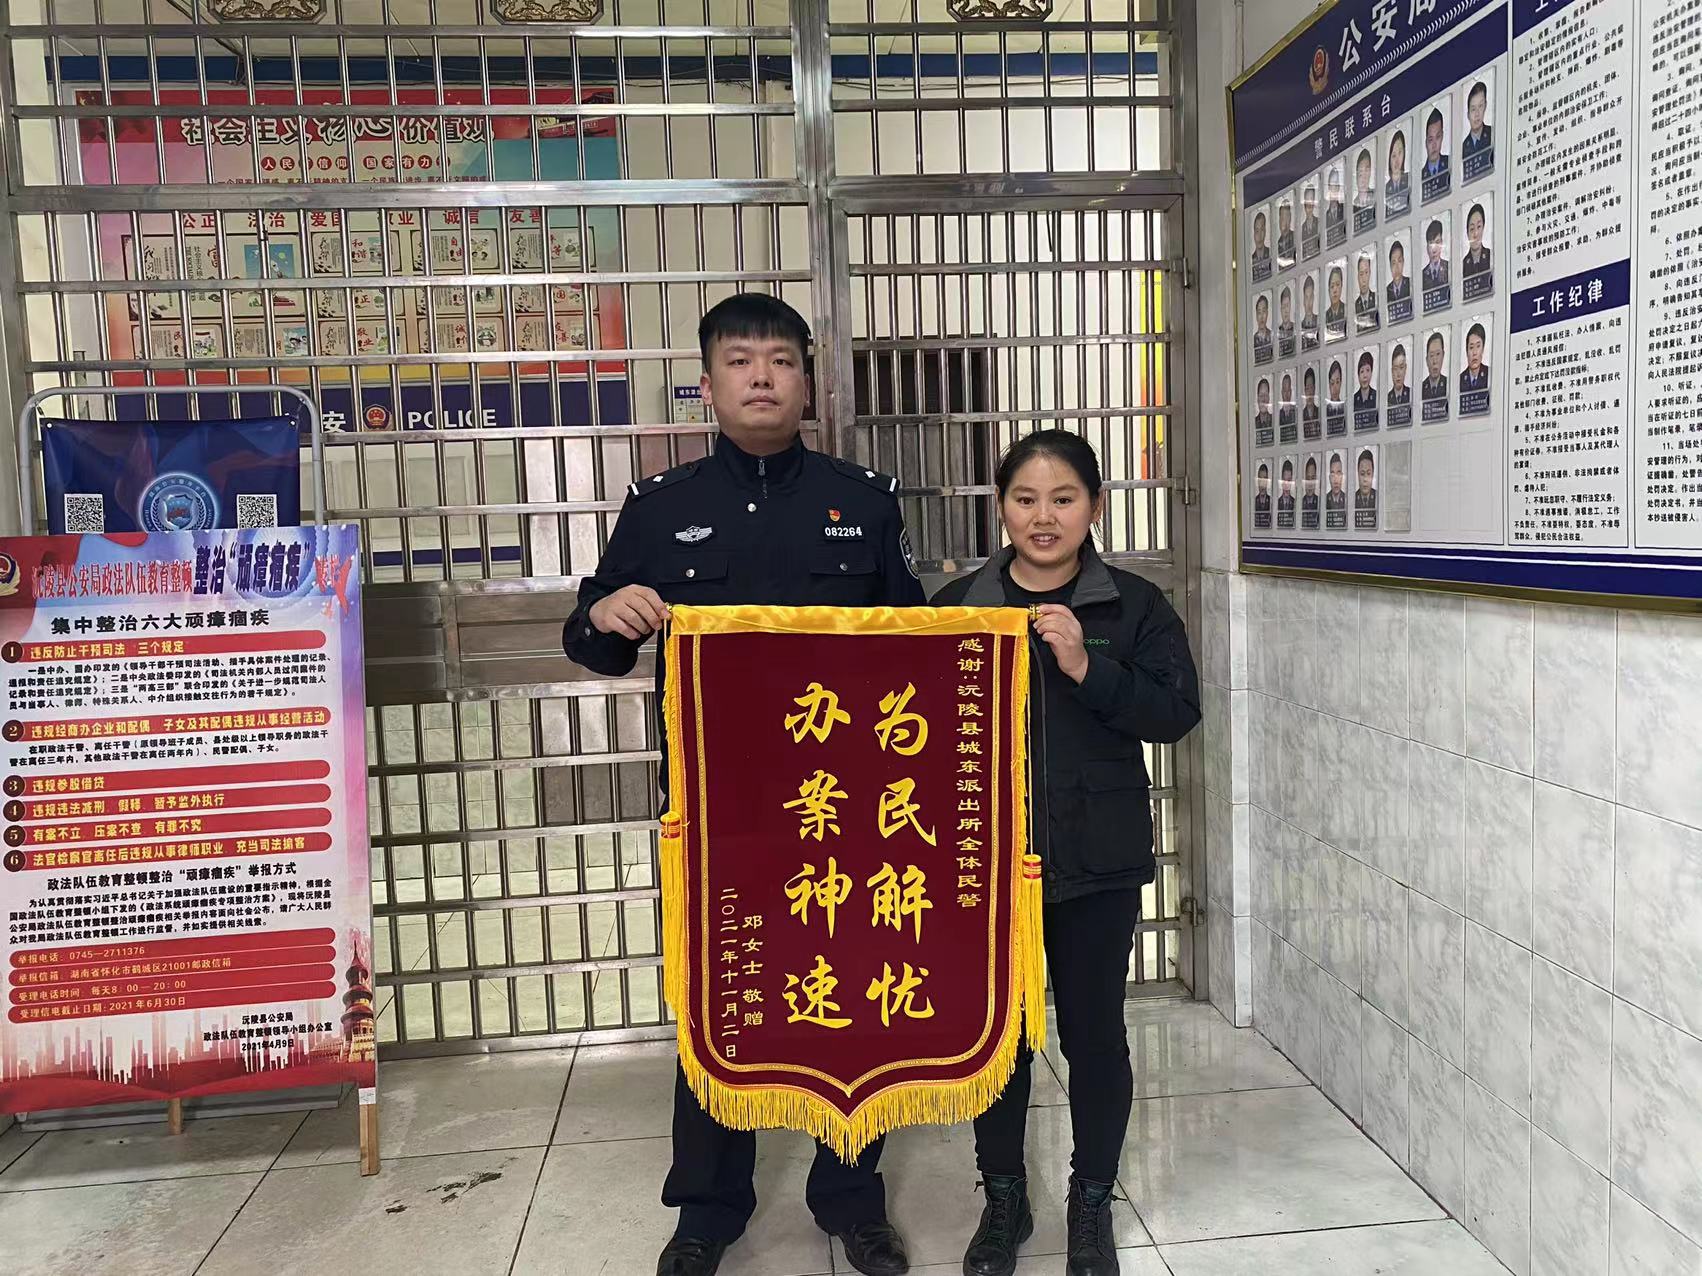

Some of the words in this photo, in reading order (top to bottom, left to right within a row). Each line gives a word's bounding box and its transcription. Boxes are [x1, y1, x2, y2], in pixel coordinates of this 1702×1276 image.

[1314, 94, 1391, 160] 警民联系台
[263, 157, 350, 171] 人民信仰
[366, 156, 450, 169] 国家有力
[1532, 277, 1603, 319] 工作纪律
[408, 408, 497, 431] POLICE
[824, 526, 863, 538] 082264
[51, 608, 270, 636] 集中整治六大顽瘴痼疾
[30, 642, 125, 660] 违反防止干预司法
[137, 640, 184, 656] 三个规定
[31, 719, 150, 739] 违规经商办企业和配偶
[163, 711, 325, 731] 子女及其配偶违规从事经营活动
[32, 776, 105, 793] 违规参股借贷
[154, 793, 225, 810] 暂予监外执行
[155, 819, 202, 834] 有罪不究
[782, 681, 854, 1030] 办案神速
[865, 681, 937, 1028] 为民解忧
[741, 914, 764, 1027] 邓女士敬赠
[241, 1011, 294, 1026] 沅陵县公安局
